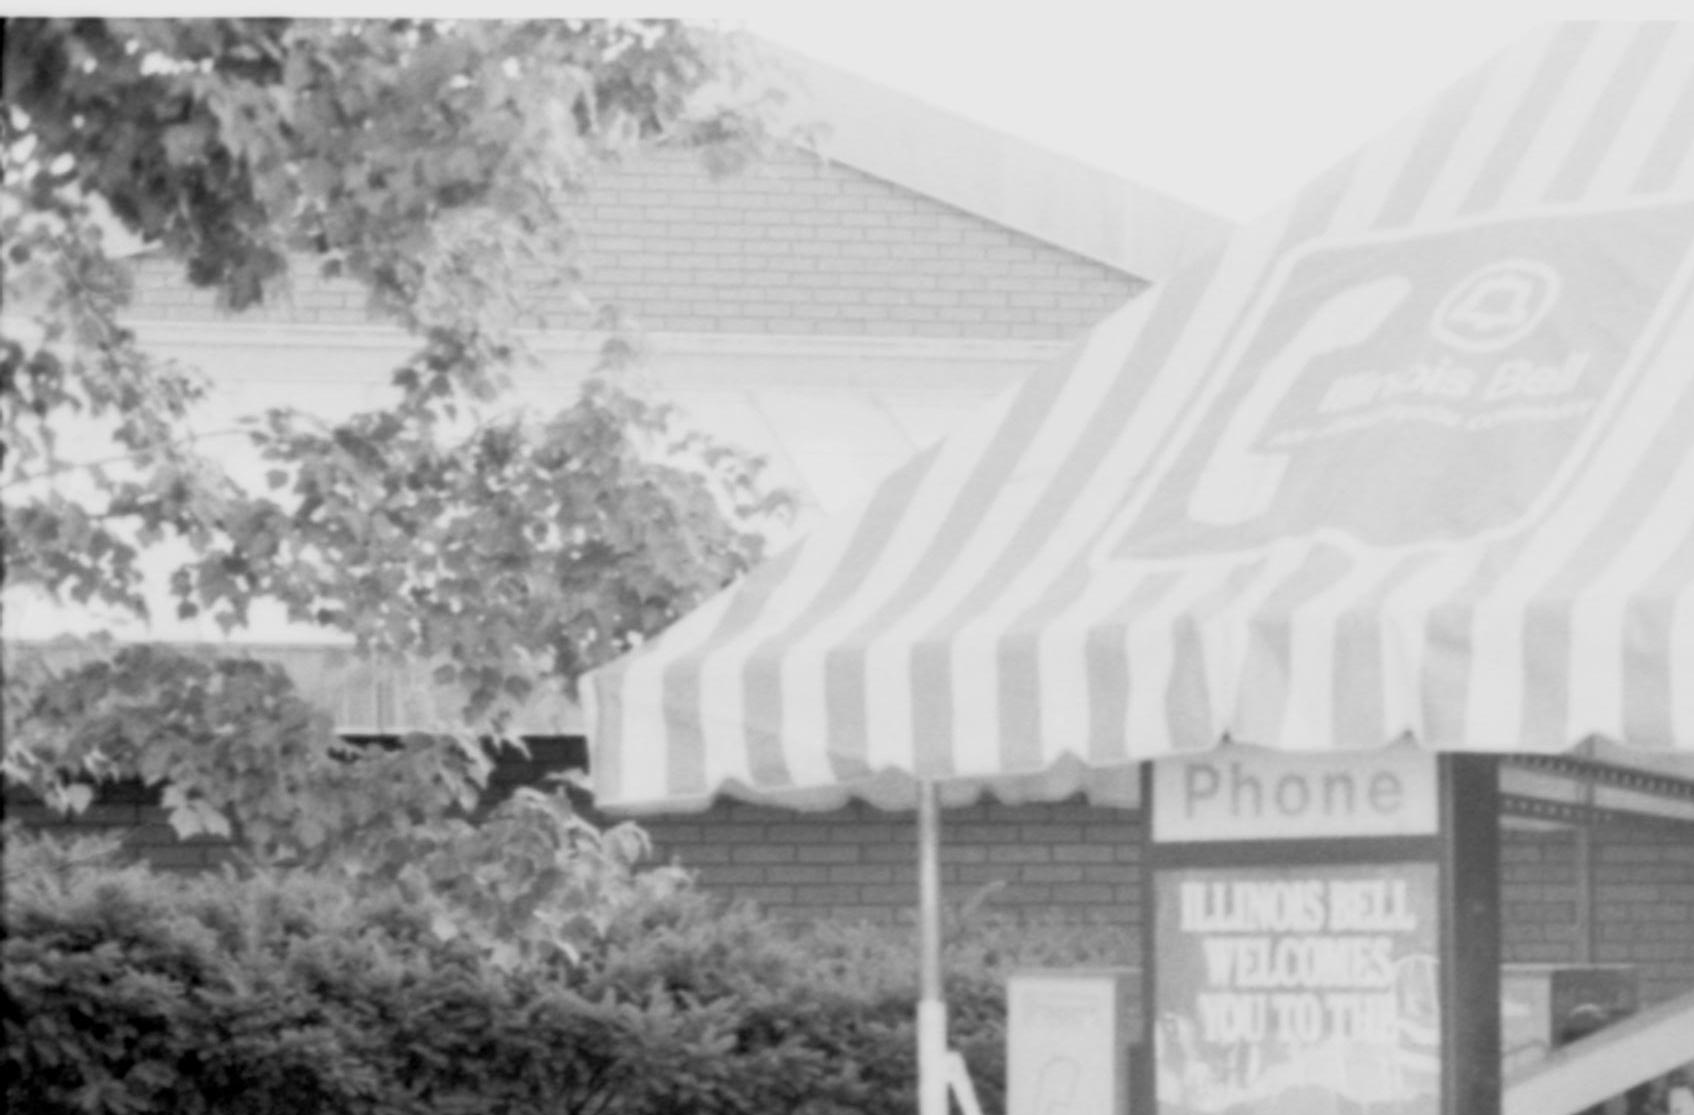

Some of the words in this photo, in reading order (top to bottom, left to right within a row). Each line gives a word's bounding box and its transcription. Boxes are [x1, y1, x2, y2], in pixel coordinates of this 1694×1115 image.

[1317, 354, 1478, 415] nois
[1183, 761, 1405, 820] Phone
[1182, 881, 1325, 931] ILLINOIS
[1329, 879, 1417, 931] BELL
[1204, 938, 1396, 987] WELCOMES
[1199, 993, 1266, 1042] YOU
[1273, 994, 1322, 1042] TO
[1326, 992, 1398, 1044] THE
